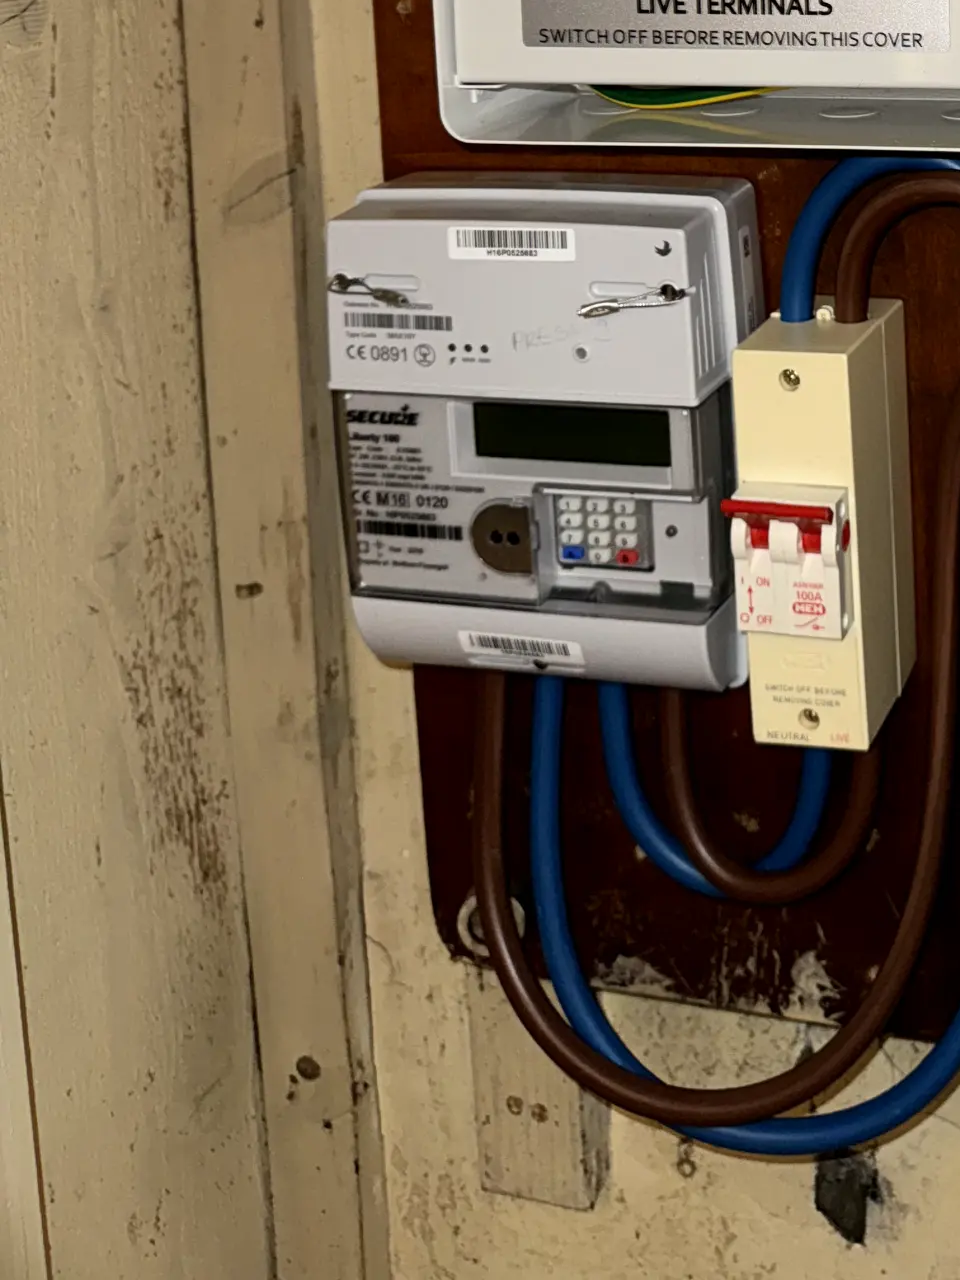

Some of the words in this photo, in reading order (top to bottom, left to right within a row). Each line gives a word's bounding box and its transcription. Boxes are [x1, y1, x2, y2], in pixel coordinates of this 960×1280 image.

[539, 29, 607, 44] SWITCH
[613, 30, 647, 44] OFF
[652, 30, 719, 45] BEFORE
[724, 30, 817, 46] REMOVING
[822, 31, 859, 47] THIS
[862, 32, 923, 48] COVER
[371, 345, 408, 362] 0891
[416, 494, 449, 509] 0120
[756, 576, 770, 587] ON
[796, 591, 824, 602] 100A
[756, 614, 773, 625] OFF
[814, 687, 847, 697] BEFORE
[767, 730, 809, 742] NEUTRAL
[830, 732, 850, 743] LIVE
